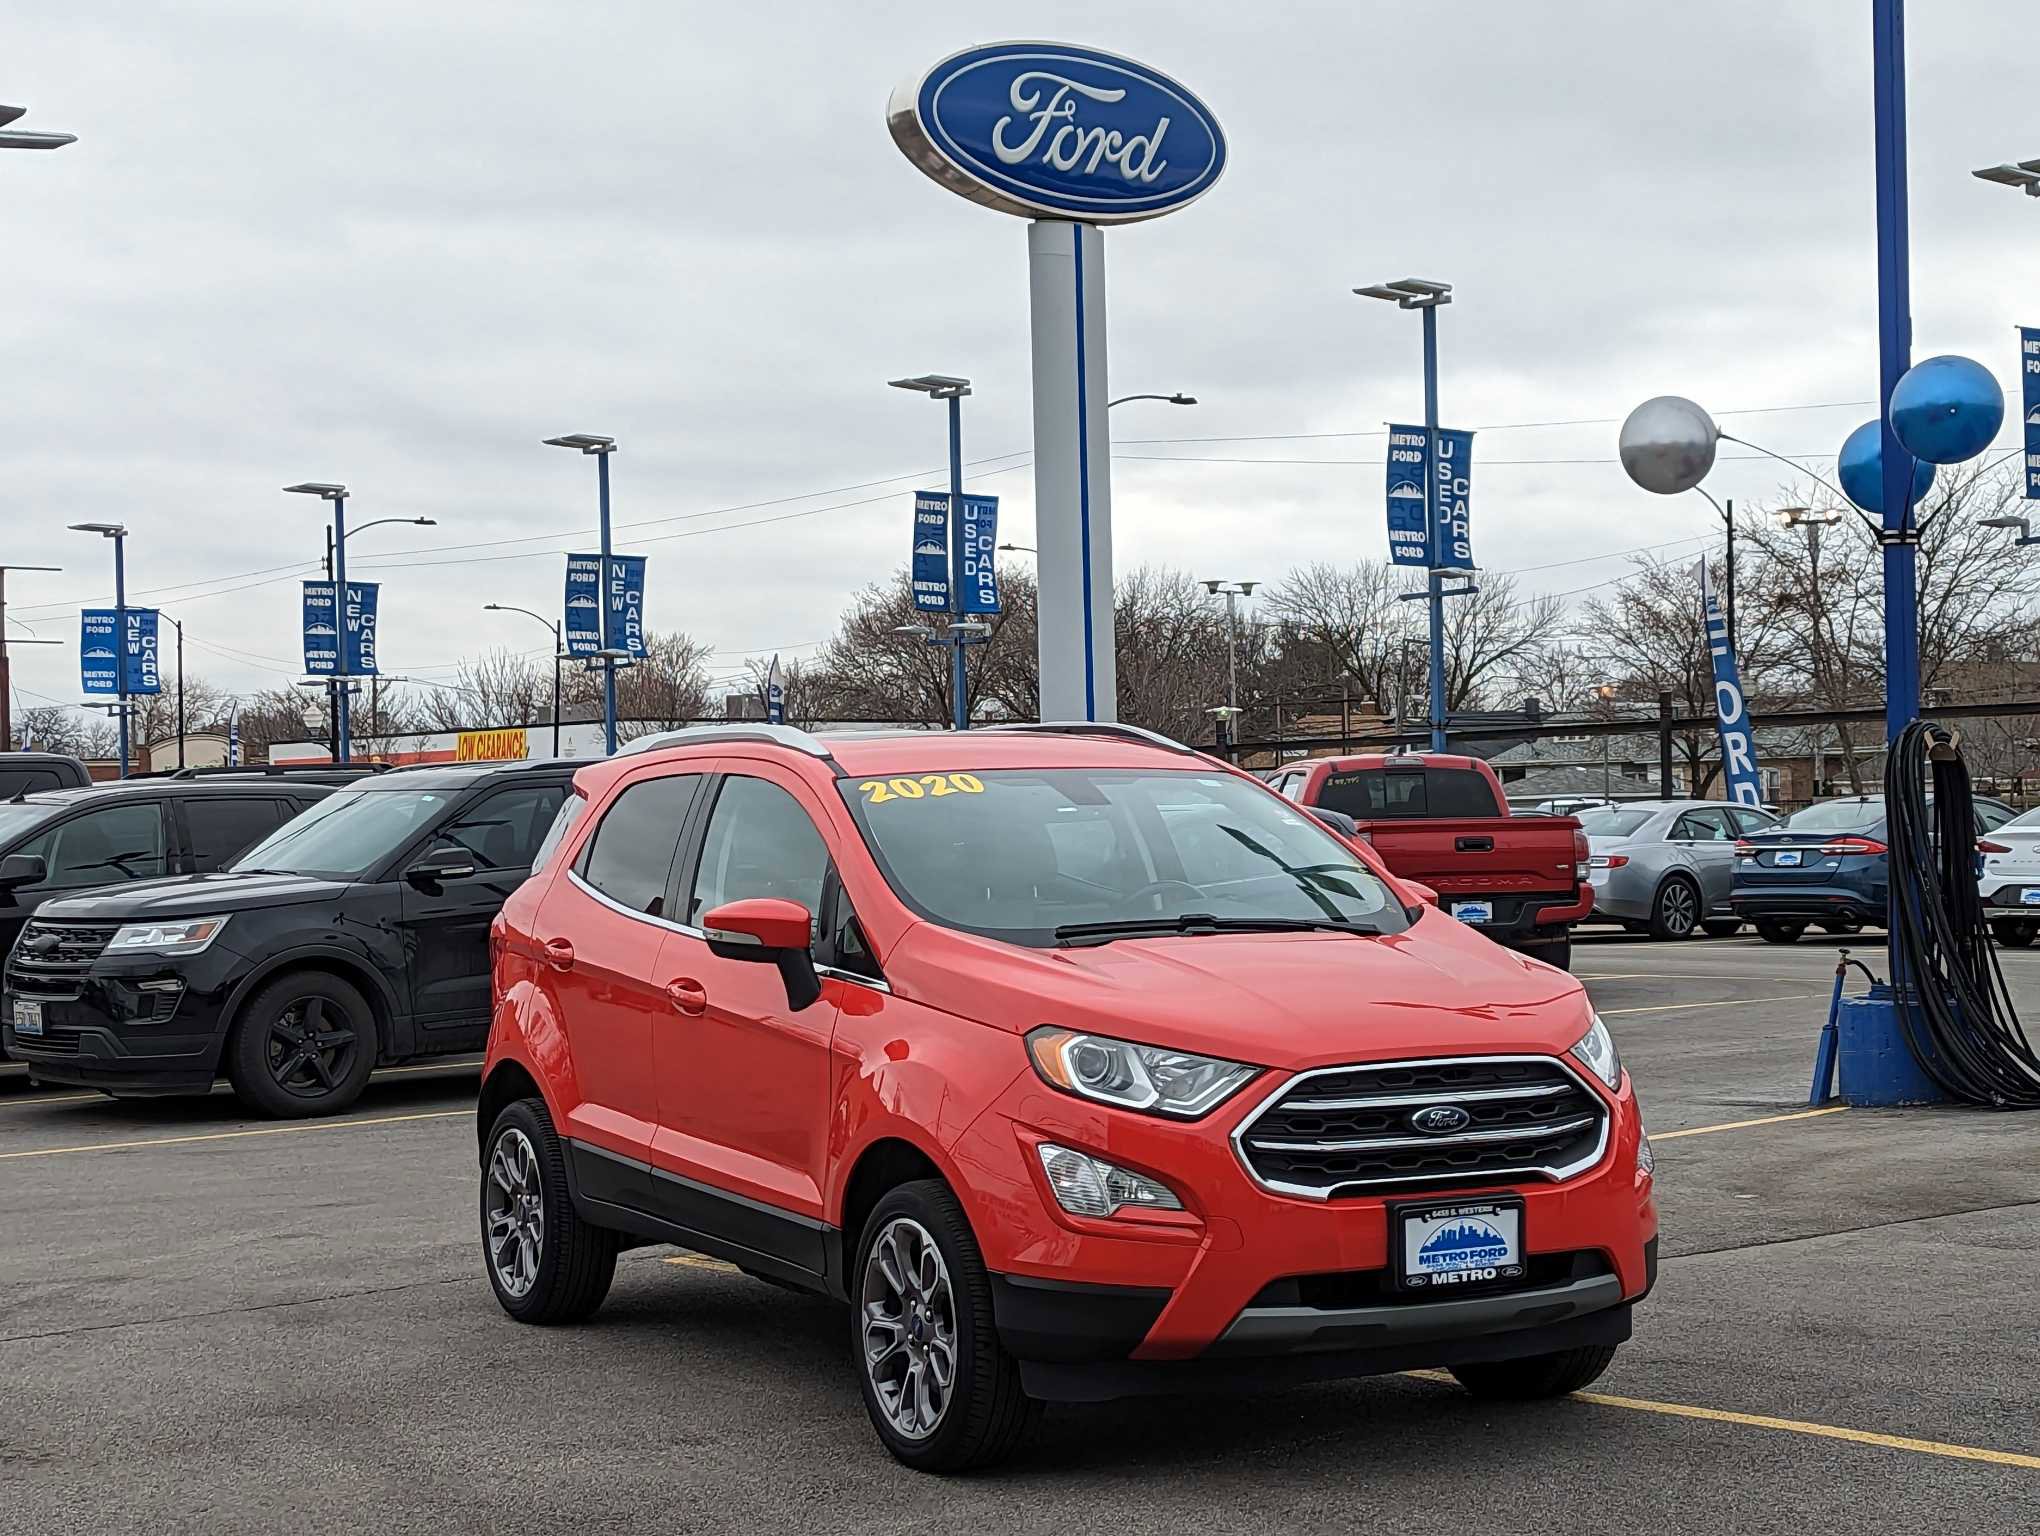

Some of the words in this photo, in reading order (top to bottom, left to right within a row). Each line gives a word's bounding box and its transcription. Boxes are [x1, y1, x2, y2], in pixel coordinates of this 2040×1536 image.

[993, 71, 1169, 182] Ford
[2026, 360, 2040, 373] FO
[1391, 433, 1426, 447] METRO
[1392, 450, 1422, 463] FORD
[1438, 439, 1453, 524] USED
[916, 499, 948, 512] METRO
[918, 514, 944, 525] FORD
[1452, 478, 1470, 559] CARS
[964, 504, 978, 576] USED
[1389, 529, 1426, 543] METRO
[1394, 545, 1424, 558] FORD
[568, 560, 600, 570] METRO
[978, 535, 995, 604] CARS
[570, 573, 596, 582] FORD
[304, 587, 334, 596] METRO
[611, 563, 626, 611] NEW
[913, 580, 947, 593] METRO
[306, 598, 332, 607] FORD
[918, 594, 945, 606] FORD
[346, 589, 362, 632] NEW
[625, 590, 642, 651] CARS
[86, 626, 112, 634] FORD
[128, 615, 140, 655] NEW
[567, 630, 600, 640] METRO
[360, 614, 375, 669] CARS
[572, 642, 598, 651] FORD
[141, 636, 158, 686] CARS
[305, 650, 337, 659] METRO
[309, 661, 335, 670] FORD
[87, 680, 113, 688] FORD
[458, 736, 475, 761] LOW
[476, 731, 523, 760] CLEARANCE
[859, 773, 985, 803] 2020
[1428, 1110, 1458, 1126] Ford
[1418, 1251, 1468, 1265] METRO
[1469, 1246, 1508, 1260] FORD
[1432, 1268, 1497, 1285] METRO
